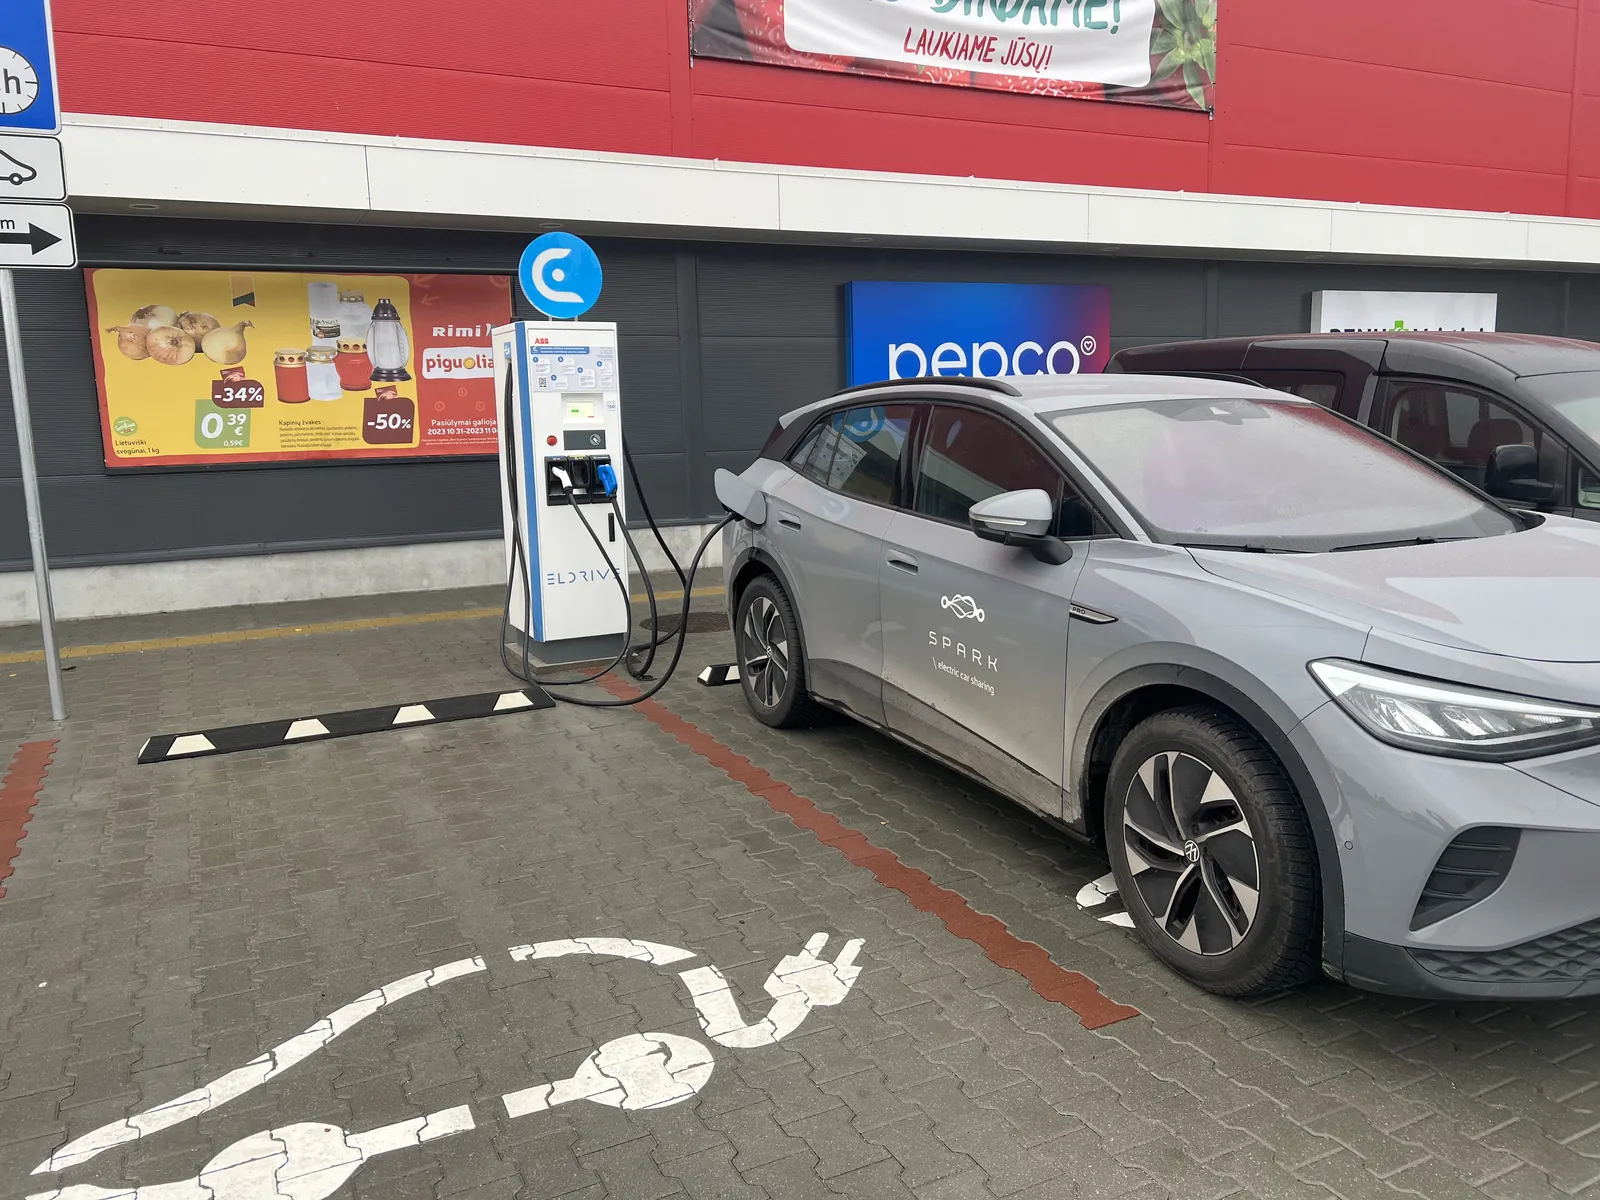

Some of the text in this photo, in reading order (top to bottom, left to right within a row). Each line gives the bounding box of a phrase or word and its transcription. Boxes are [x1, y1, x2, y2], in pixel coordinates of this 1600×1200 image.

[903, 27, 998, 63] LAUKIAME
[432, 324, 481, 337] Rimi
[534, 337, 549, 345] ABB
[214, 387, 263, 402] -34%
[201, 412, 247, 439] 0 39
[367, 413, 411, 430] -50%
[427, 428, 446, 436] 2023
[491, 427, 499, 435] 0
[1072, 606, 1086, 615] PRO
[928, 630, 998, 673] SPARK
[937, 661, 995, 696] electric car sharing
